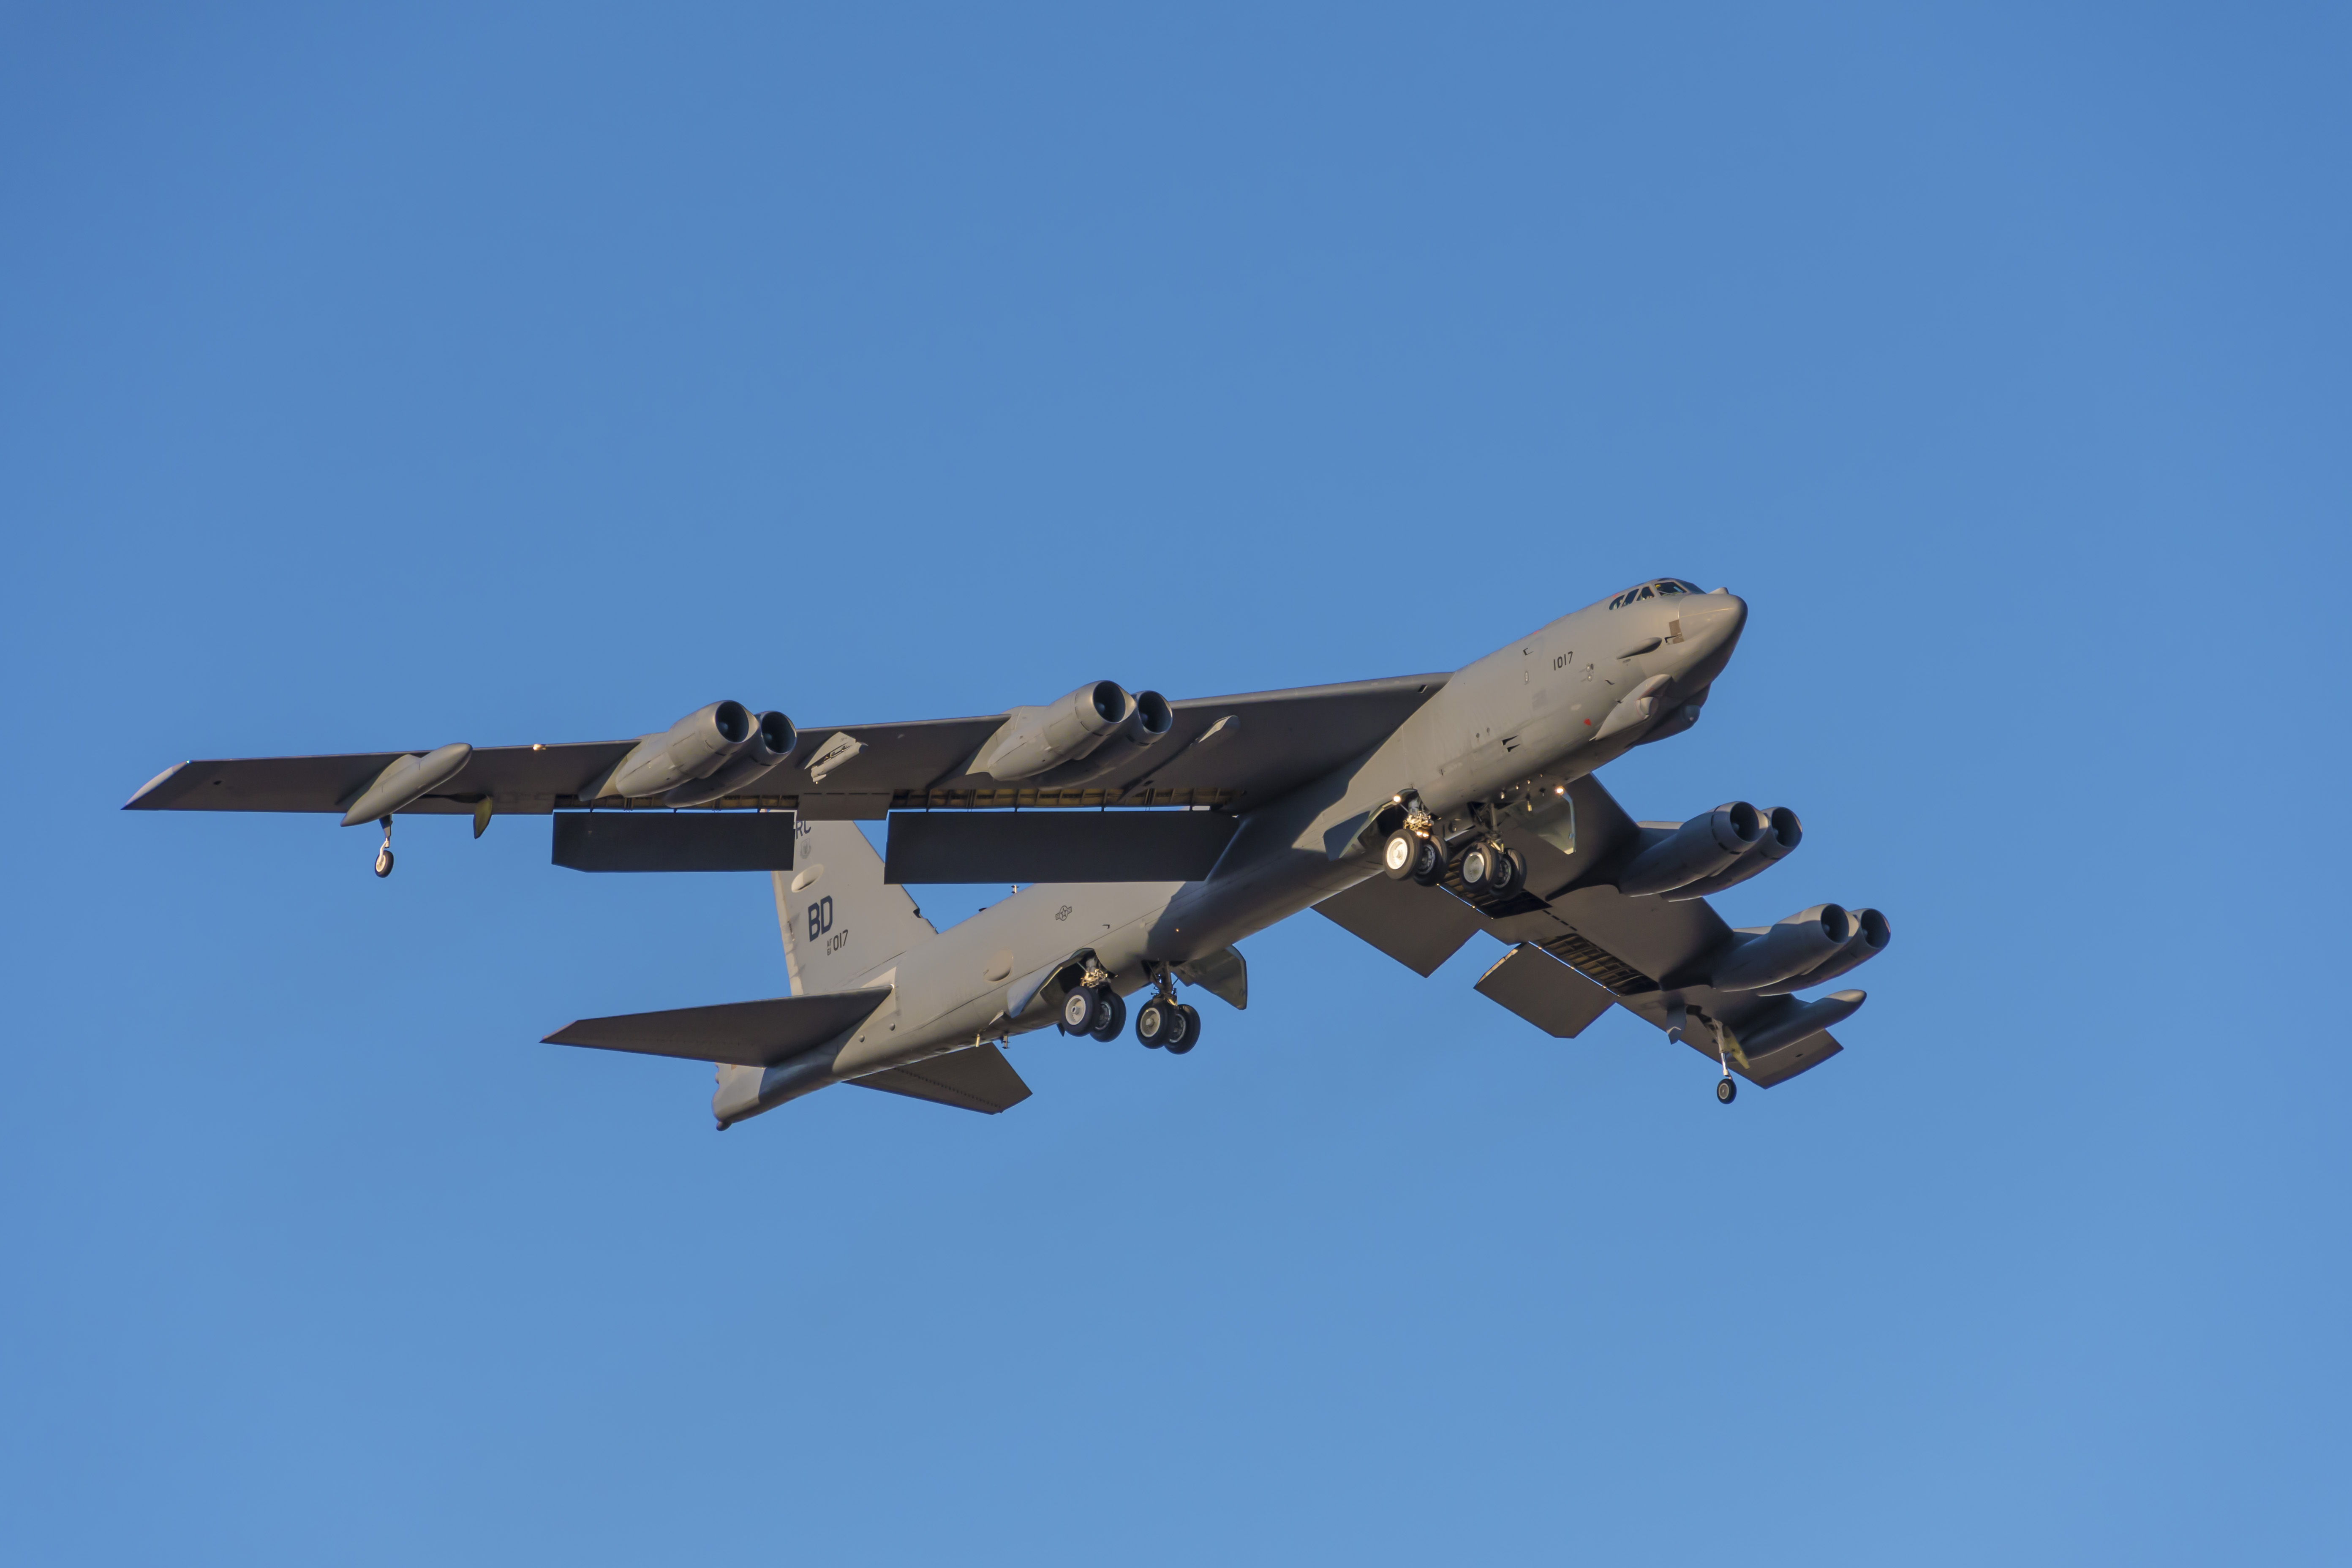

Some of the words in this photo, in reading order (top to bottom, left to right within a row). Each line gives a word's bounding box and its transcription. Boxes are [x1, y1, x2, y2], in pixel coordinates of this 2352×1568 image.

[1554, 651, 1573, 671] 1017
[794, 821, 811, 840] RC
[808, 895, 833, 942] BD
[833, 929, 849, 951] 017
